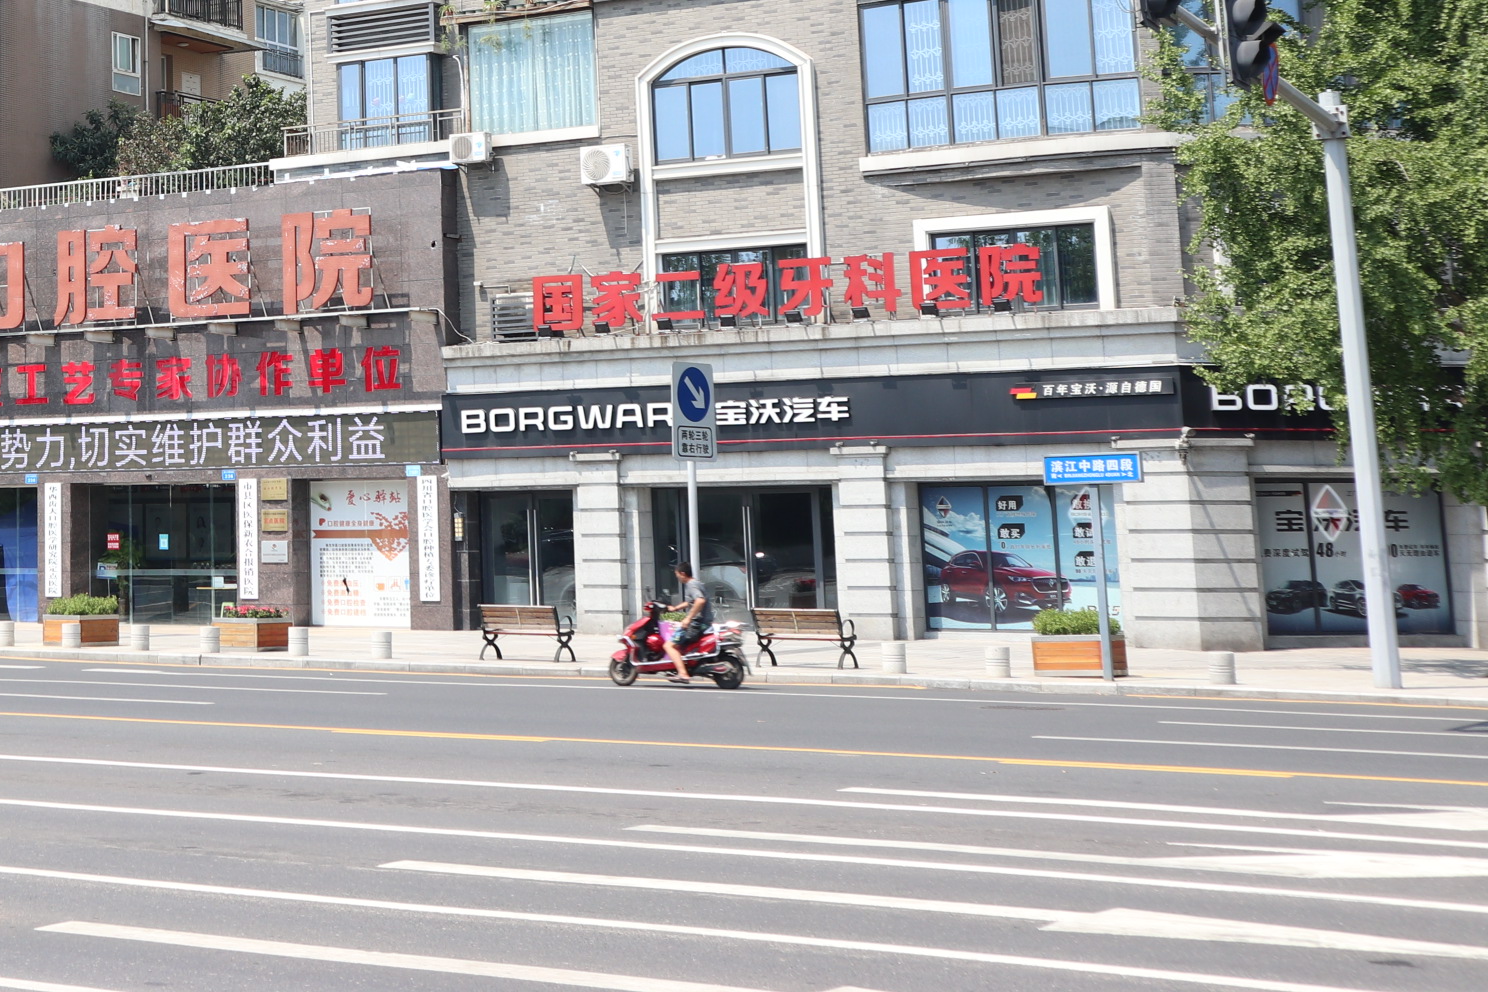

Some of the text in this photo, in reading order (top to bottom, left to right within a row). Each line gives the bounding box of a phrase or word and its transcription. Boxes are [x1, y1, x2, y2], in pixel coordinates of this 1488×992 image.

[533, 244, 1043, 331] 国家二级牙科医院
[1042, 380, 1163, 396] 百年宝沃·源自德国
[461, 396, 851, 434] BORGWAR 宝沃汽车
[681, 429, 709, 441] 两轮三轮
[681, 443, 710, 454] 靠右行驶
[1050, 458, 1134, 473] 滨江中路四段
[997, 500, 1017, 510] 好用
[999, 528, 1021, 539] 敢买
